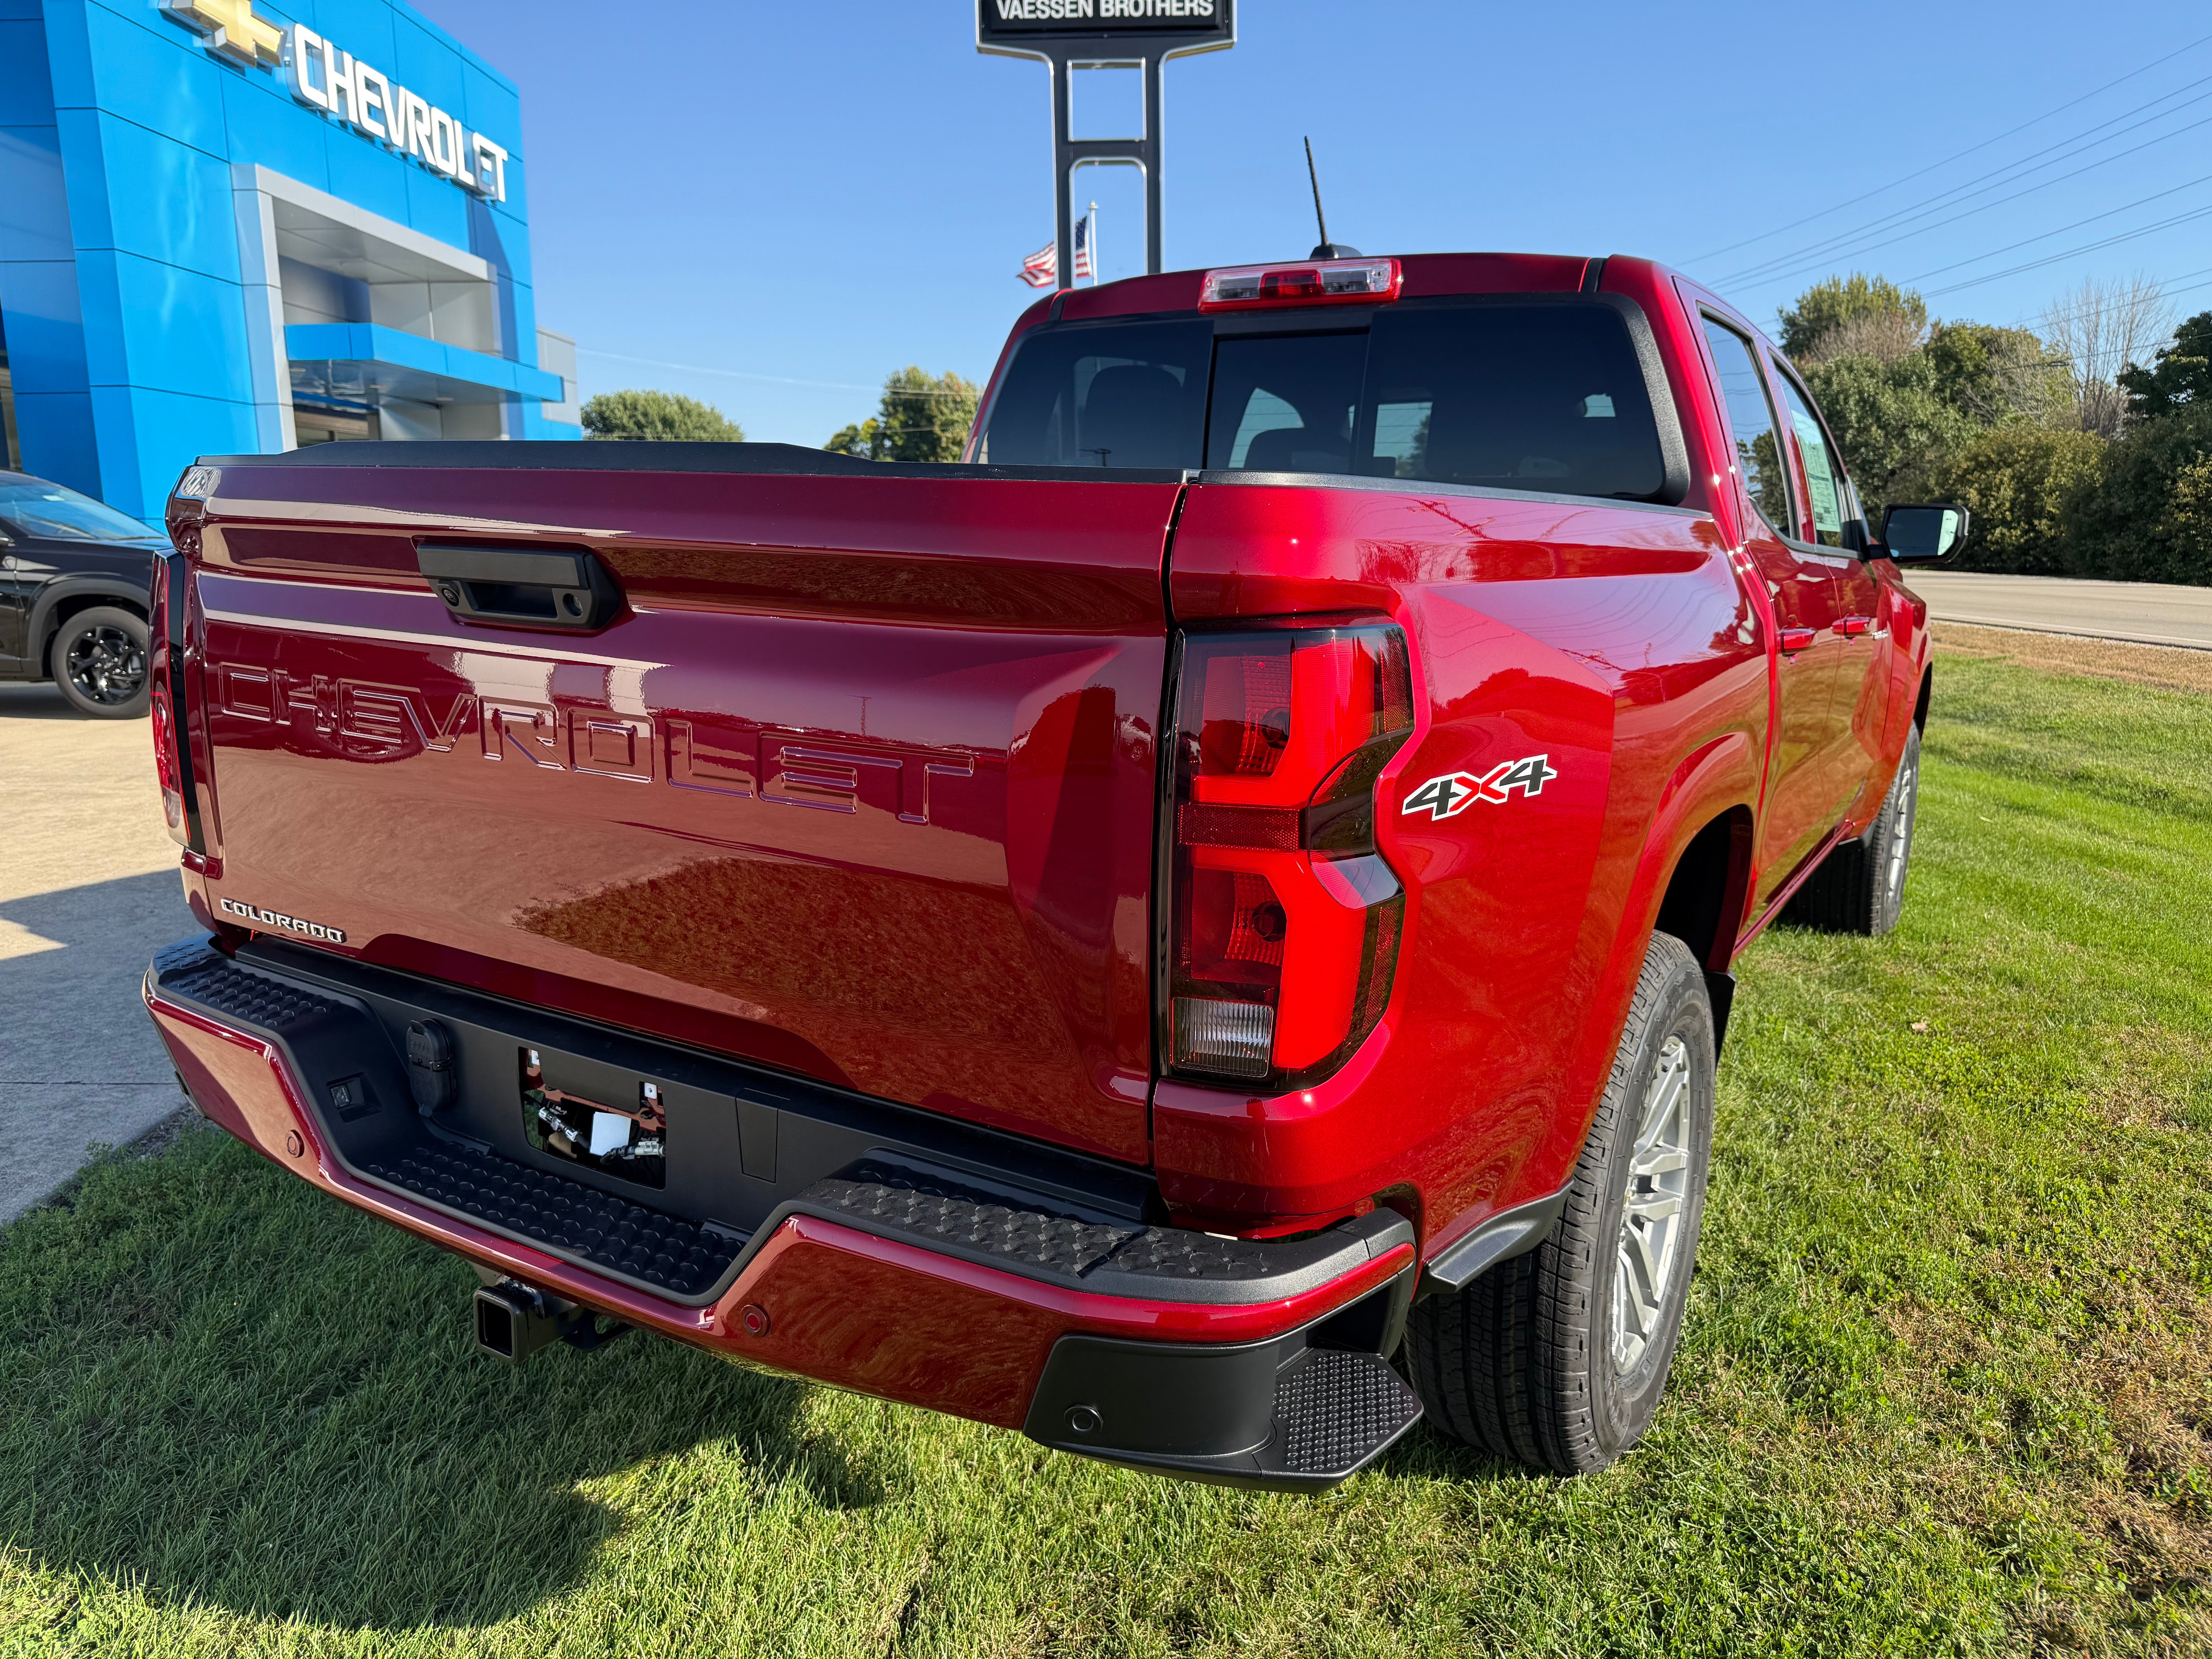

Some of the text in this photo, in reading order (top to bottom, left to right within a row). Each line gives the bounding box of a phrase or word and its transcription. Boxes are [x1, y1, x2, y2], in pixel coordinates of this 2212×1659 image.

[996, 0, 1214, 19] VAESSEN BROTHERS
[292, 23, 507, 202] CHEVROLET
[218, 662, 974, 824] CHEVROLET
[220, 898, 347, 943] COLORADO
